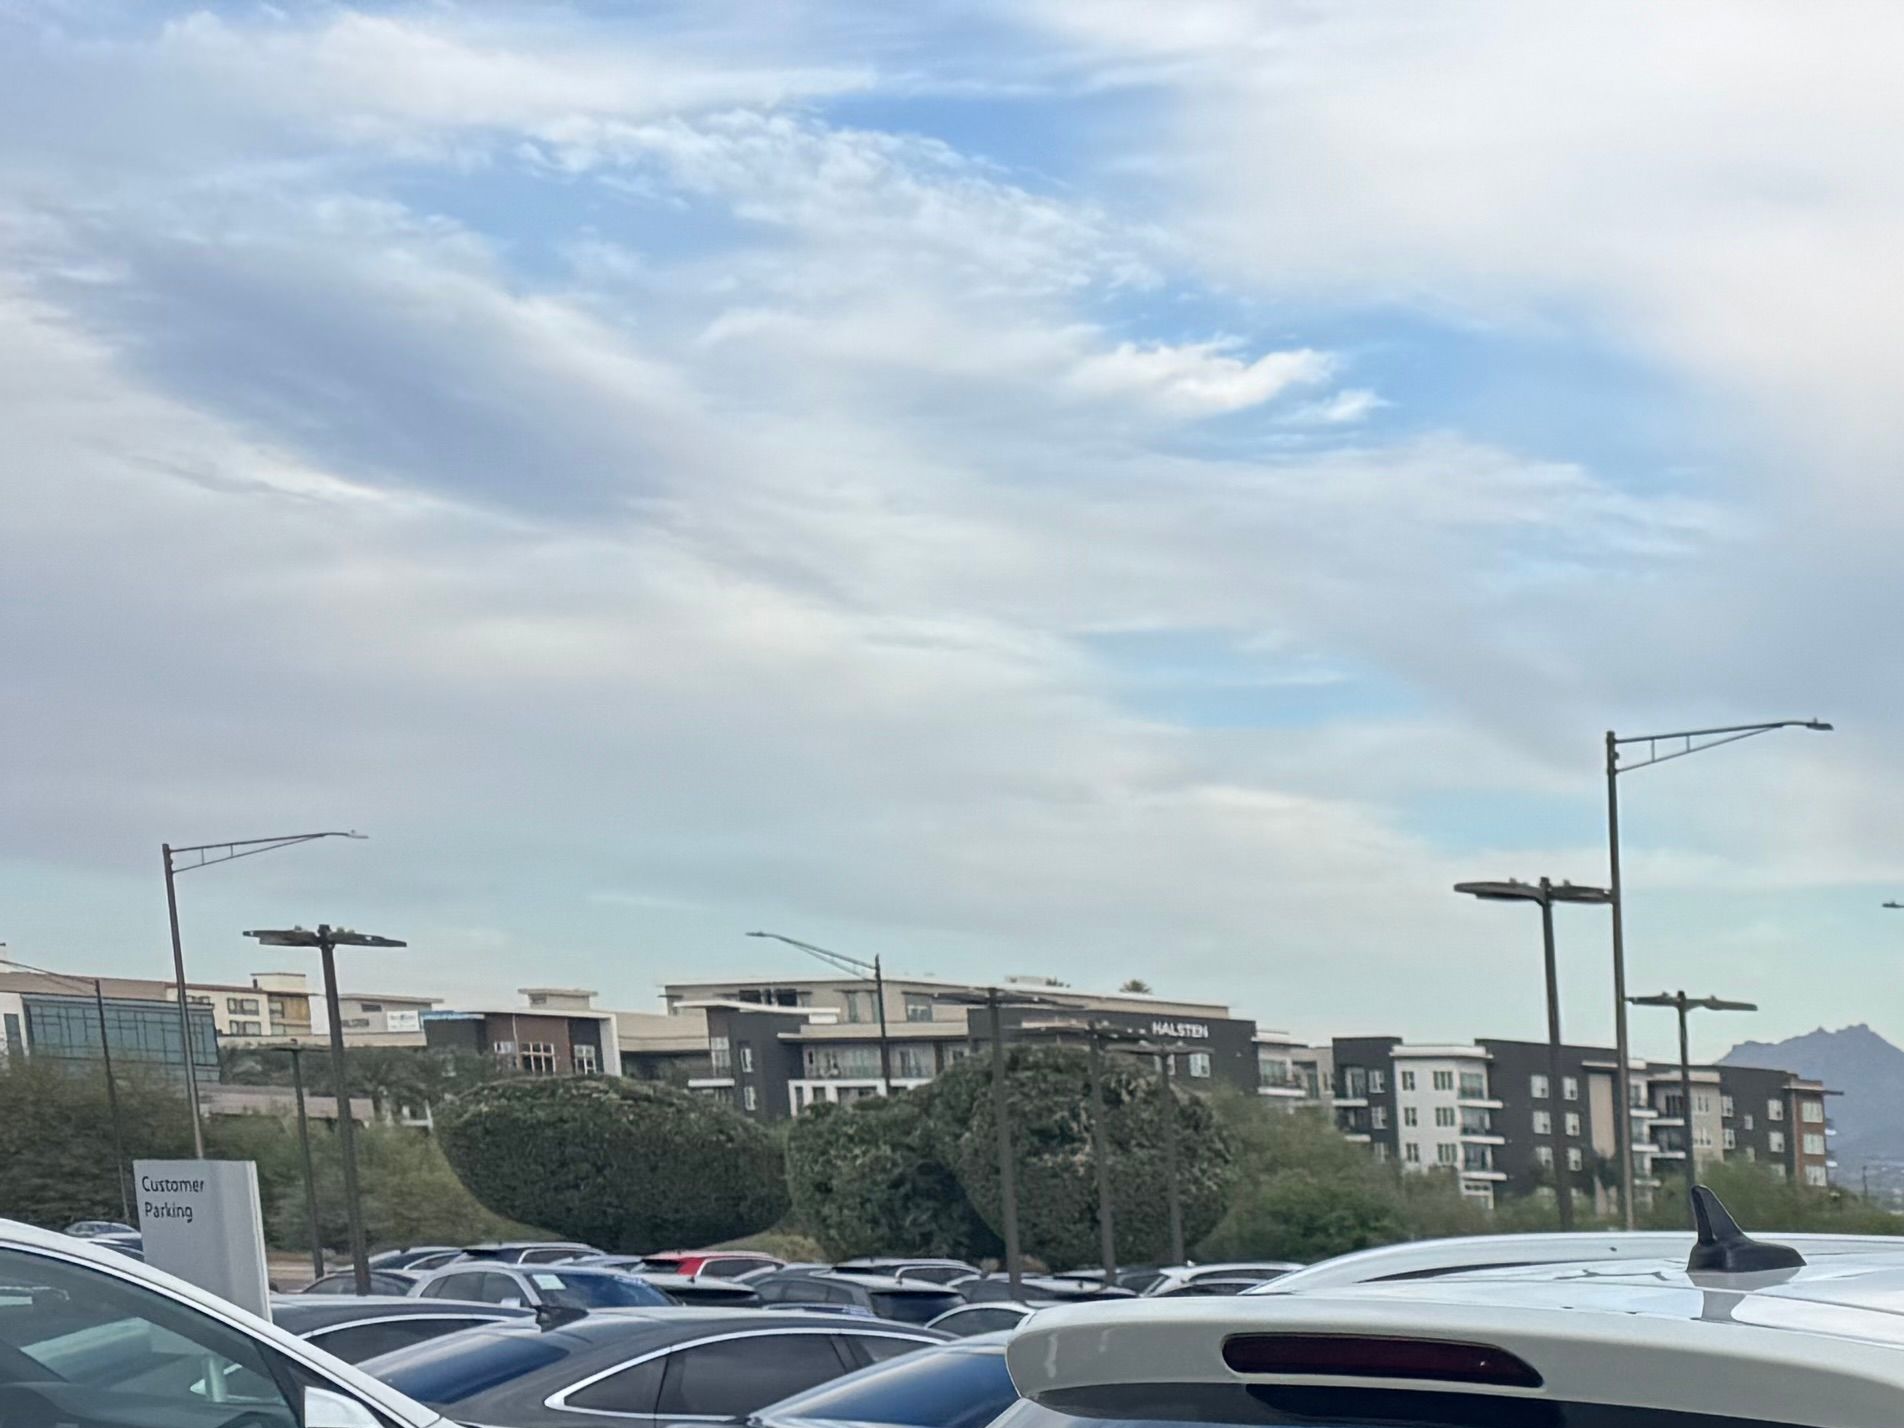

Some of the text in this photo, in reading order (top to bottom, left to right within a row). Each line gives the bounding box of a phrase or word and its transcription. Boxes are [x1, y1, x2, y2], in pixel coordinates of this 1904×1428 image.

[1152, 1021, 1209, 1038] HALSTEN
[141, 1176, 205, 1193] Customer
[144, 1201, 193, 1224] Parking
